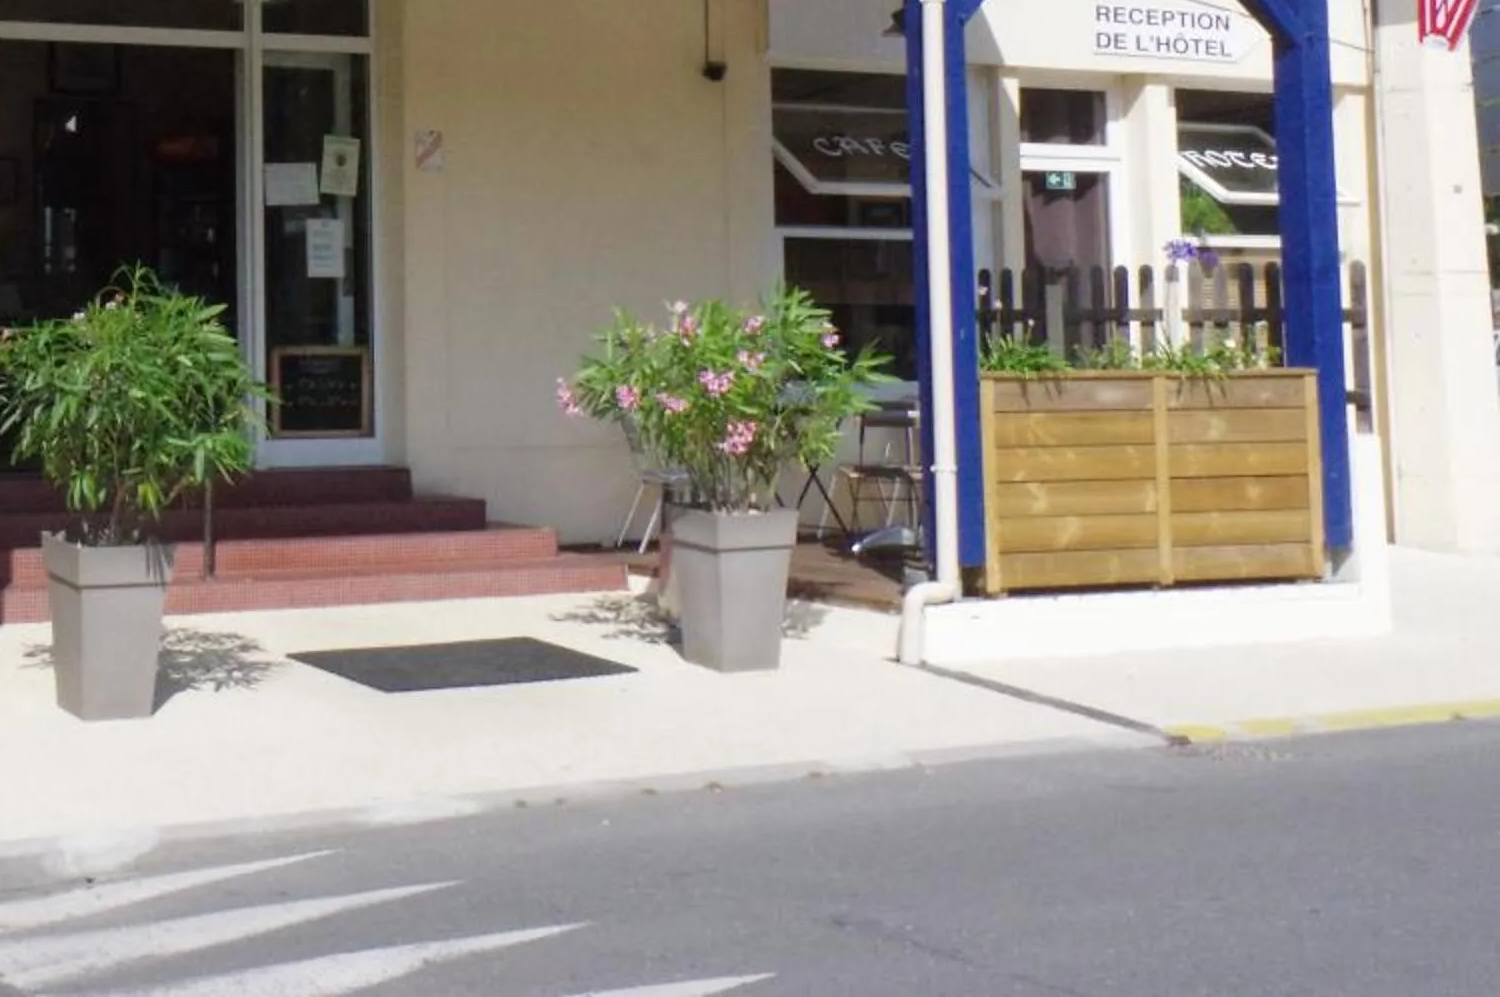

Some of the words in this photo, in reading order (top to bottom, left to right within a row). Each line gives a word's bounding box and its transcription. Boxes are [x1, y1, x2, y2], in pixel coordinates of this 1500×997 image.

[1095, 5, 1231, 32] RECEPTION
[1096, 32, 1128, 50] DE
[1135, 32, 1233, 58] L'HÔTEL
